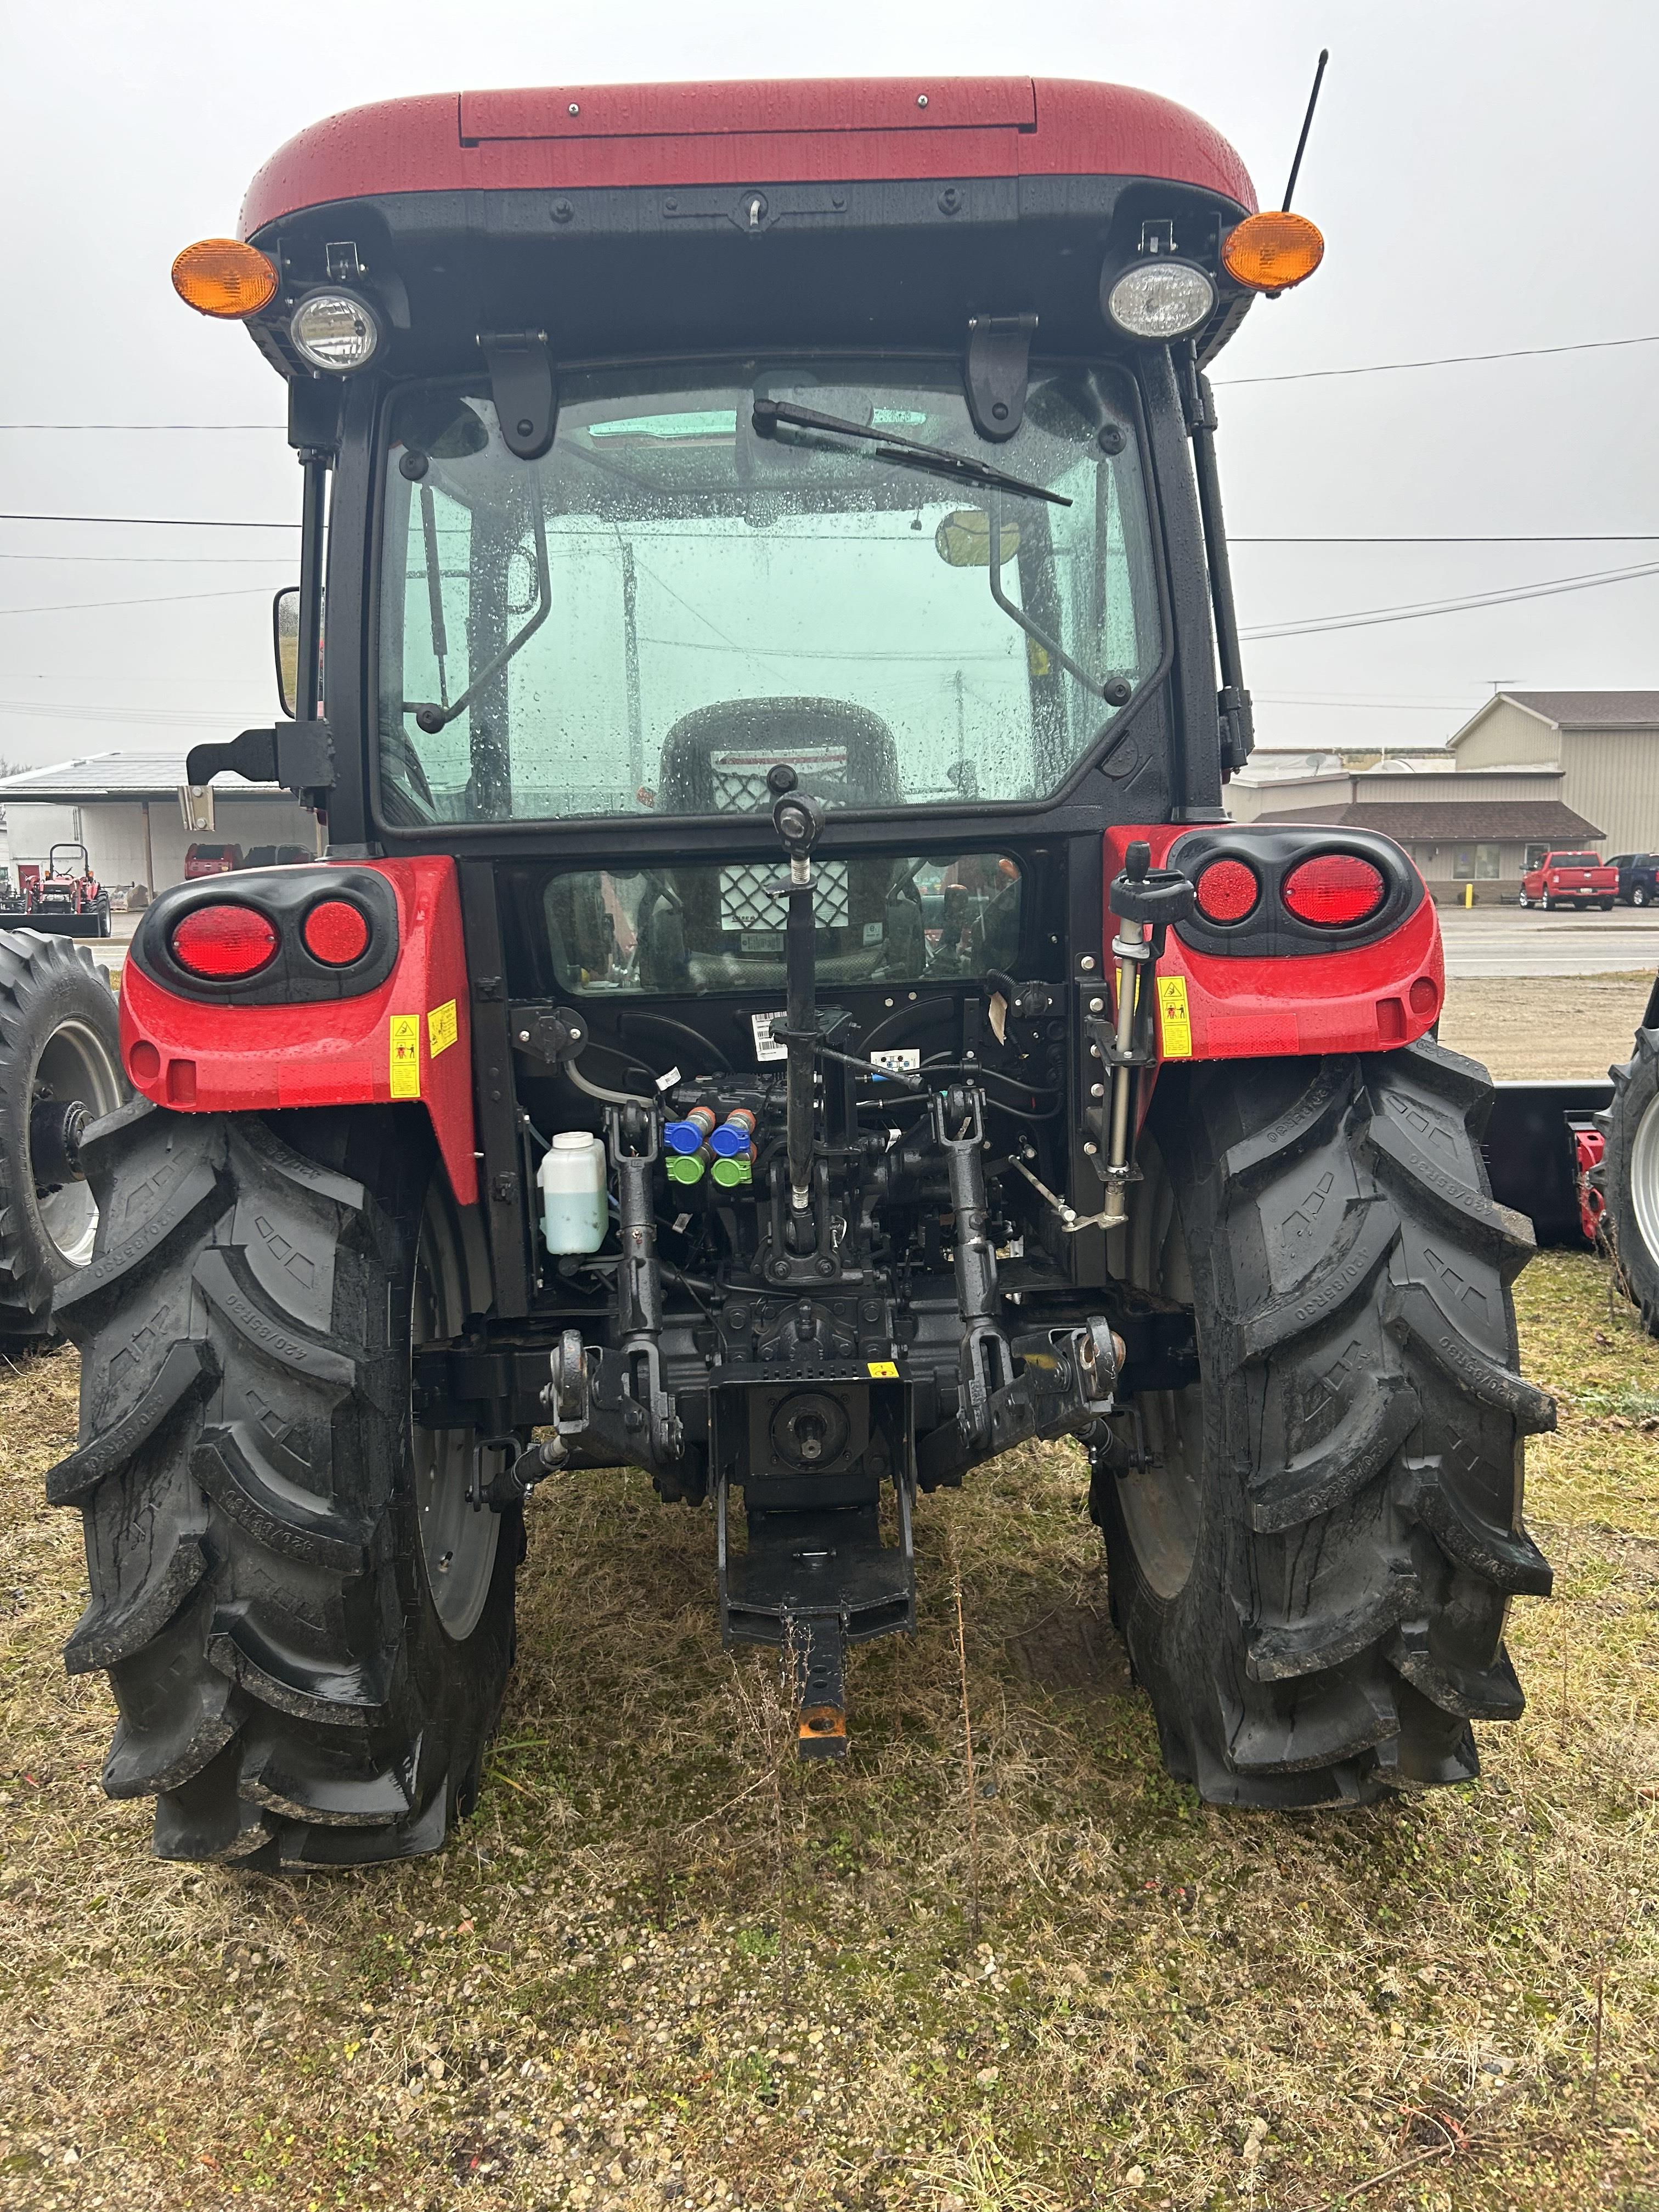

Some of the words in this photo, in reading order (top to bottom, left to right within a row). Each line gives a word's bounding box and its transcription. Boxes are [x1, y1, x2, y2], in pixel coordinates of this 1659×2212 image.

[1409, 1153, 1493, 1216] 420/85R30
[94, 1207, 177, 1278] 420/85R30
[1295, 1247, 1369, 1321] 420/85R30
[225, 1294, 308, 1361] 420/85R30
[1438, 1336, 1520, 1402] 420/85R30
